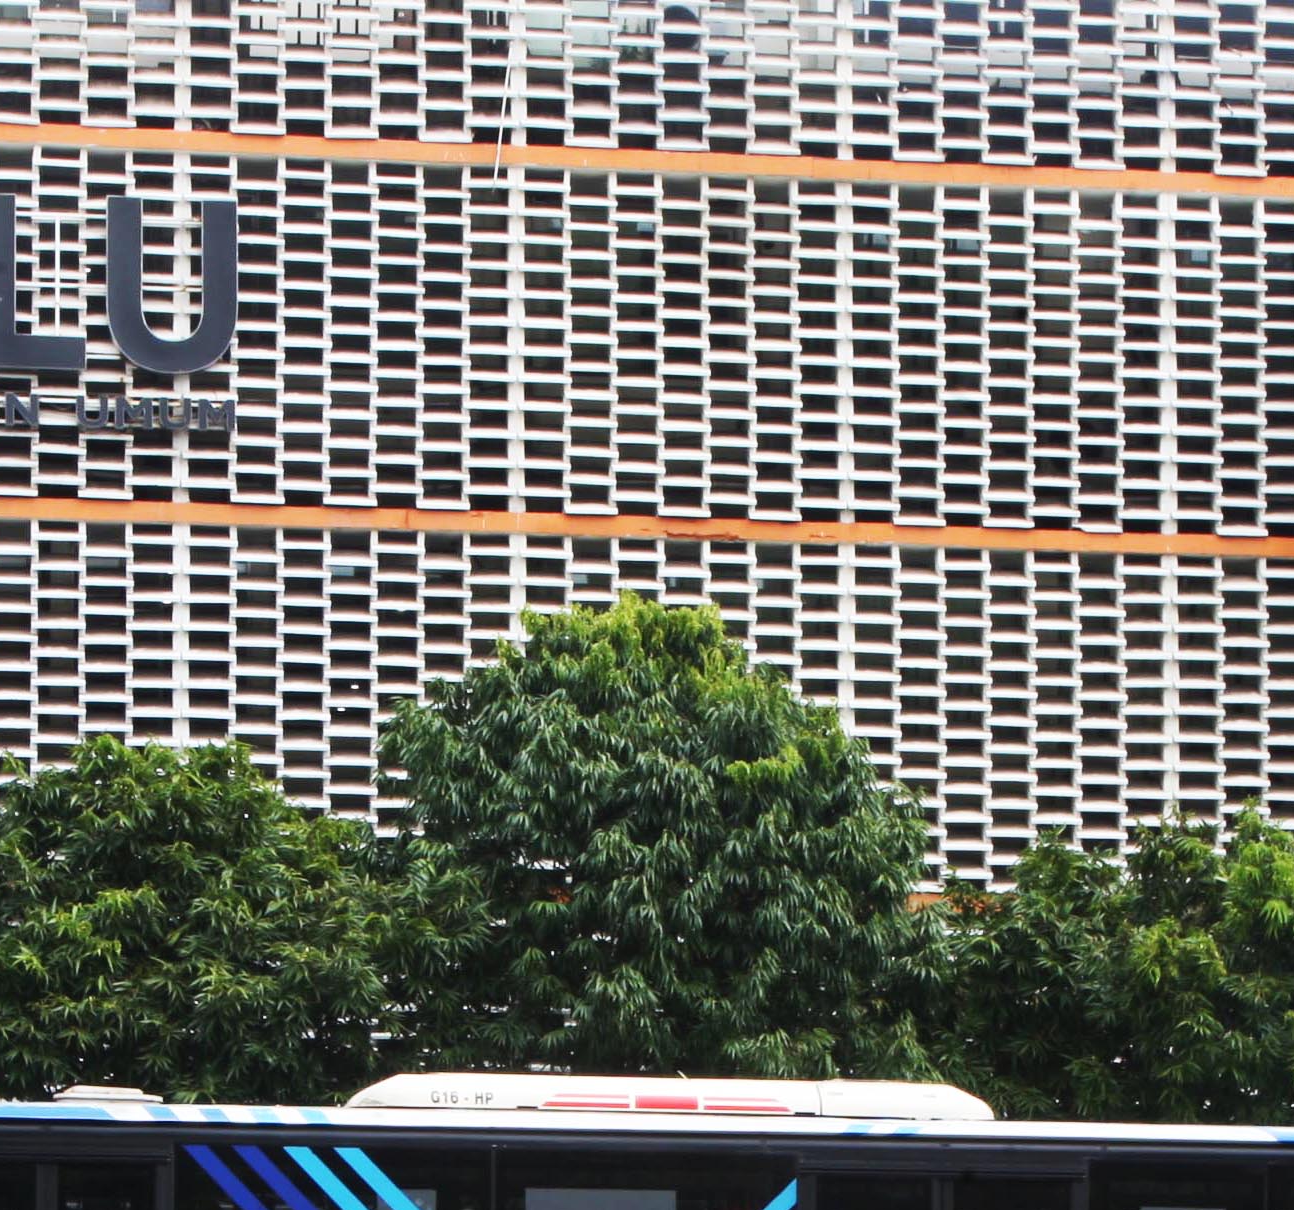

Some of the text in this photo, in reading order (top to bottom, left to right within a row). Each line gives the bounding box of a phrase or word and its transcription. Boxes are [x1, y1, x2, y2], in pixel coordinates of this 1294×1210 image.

[75, 396, 236, 433] UMUM
[430, 1090, 459, 1104] G16
[474, 1091, 494, 1105] HP
